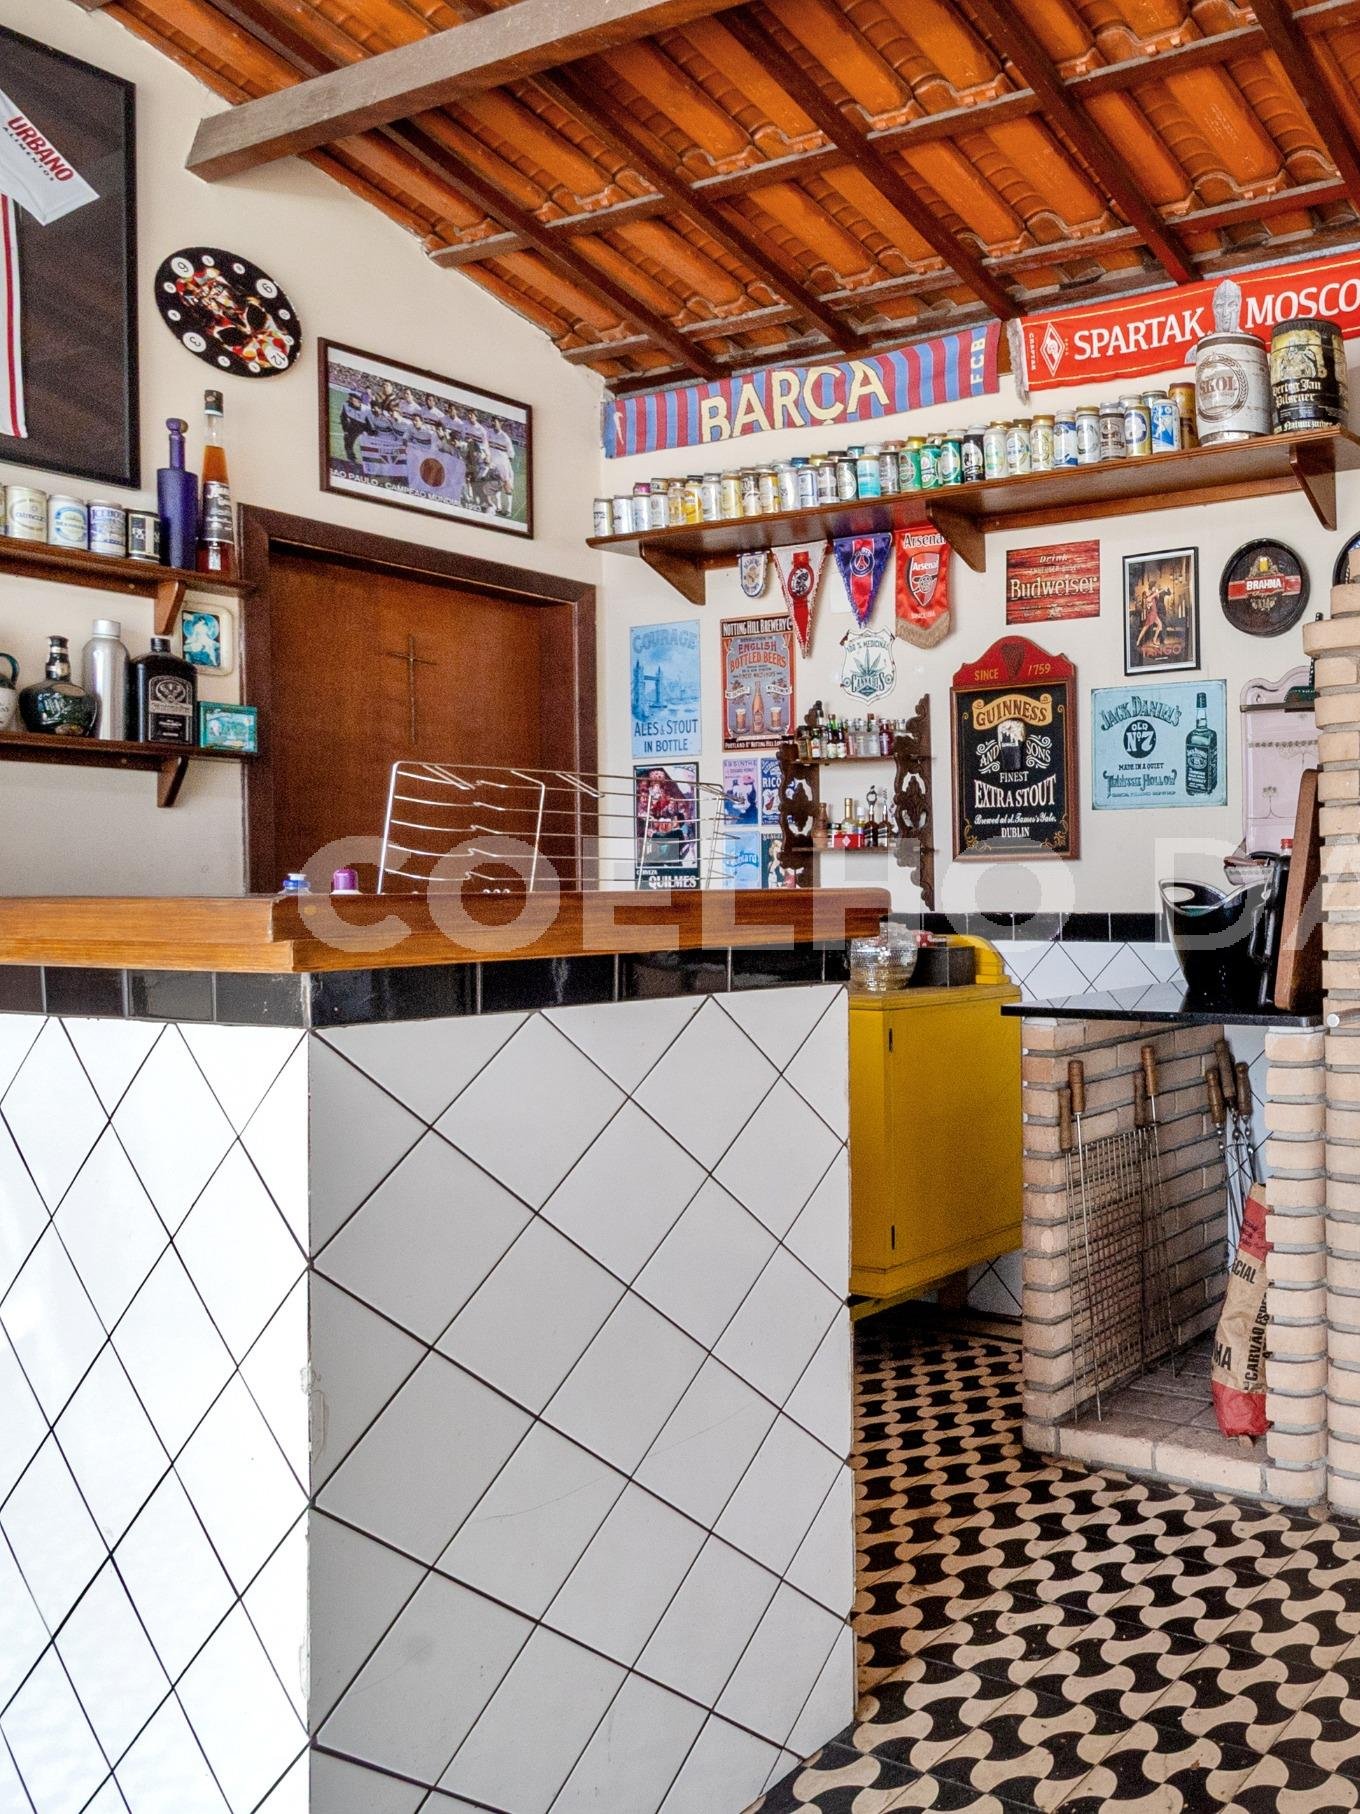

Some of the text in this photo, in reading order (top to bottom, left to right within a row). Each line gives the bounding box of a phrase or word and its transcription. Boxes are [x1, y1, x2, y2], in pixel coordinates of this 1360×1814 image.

[8, 116, 74, 181] URBANO
[1073, 307, 1206, 361] SPARTAK
[970, 337, 986, 385] FCB
[701, 361, 890, 444] BARÇA
[348, 471, 379, 487] PAULO
[903, 532, 946, 549] Arsena
[1010, 574, 1097, 601] Budweiser
[738, 641, 777, 654] ENGLISH
[730, 652, 762, 672] BOTTLED
[763, 651, 787, 668] BEERS
[974, 663, 1051, 681] SINCE 1759
[975, 698, 1047, 727] GUINNESS
[634, 721, 660, 738] ALES
[666, 719, 698, 736] STOUT
[643, 738, 689, 753] IN BOTTLE
[979, 739, 1051, 767] AND SONS
[999, 770, 1029, 783] FINEST
[974, 774, 1057, 808] EXTRA STOUT
[1001, 827, 1030, 838] DUBLIN
[648, 875, 698, 889] QUILMES
[1245, 1327, 1265, 1382] CARVÃO
